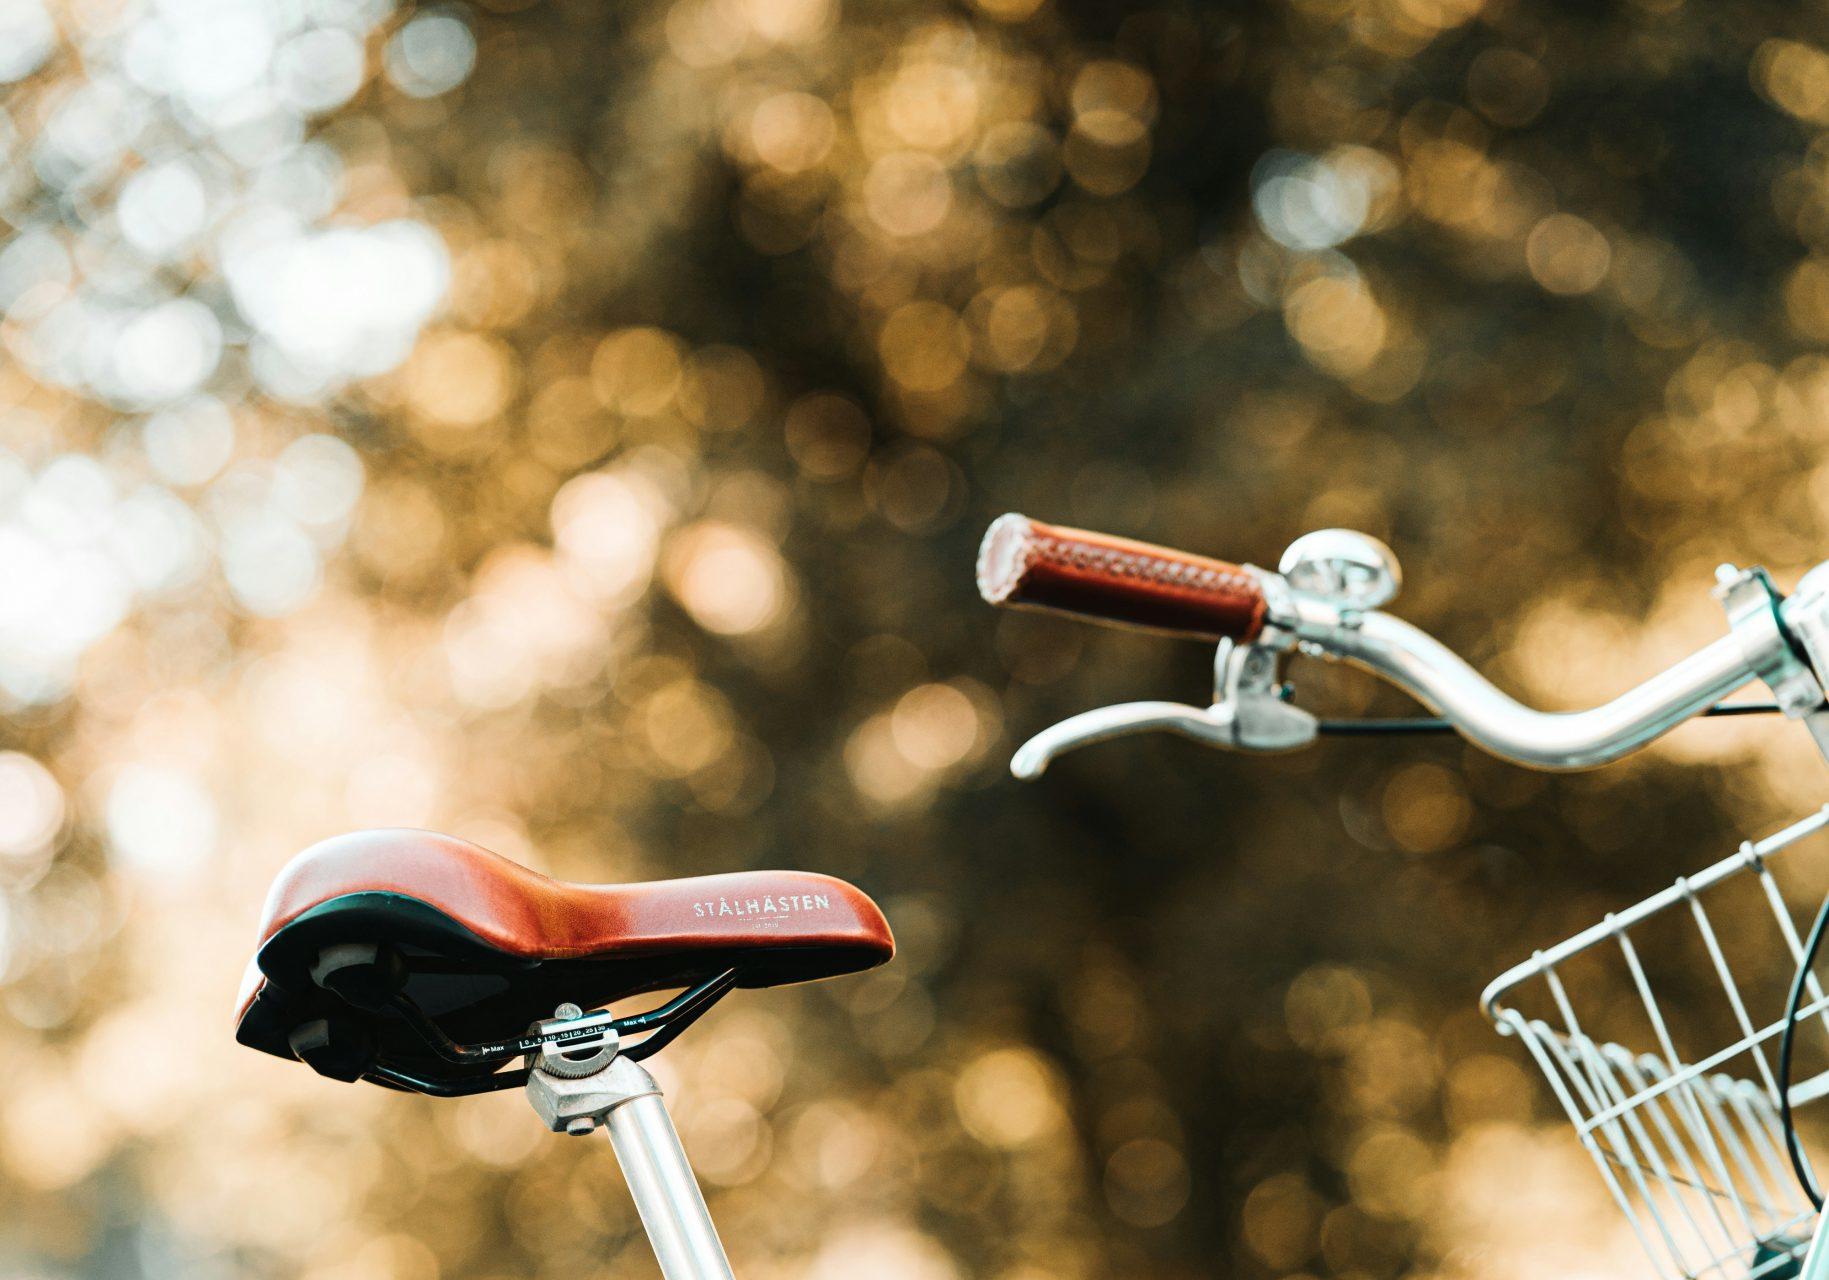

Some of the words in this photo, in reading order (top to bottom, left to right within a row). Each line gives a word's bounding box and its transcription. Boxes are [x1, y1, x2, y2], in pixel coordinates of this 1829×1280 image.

[693, 894, 830, 918] STÅLHÄSTEN
[624, 1019, 637, 1027] Max
[490, 1045, 504, 1053] Max
